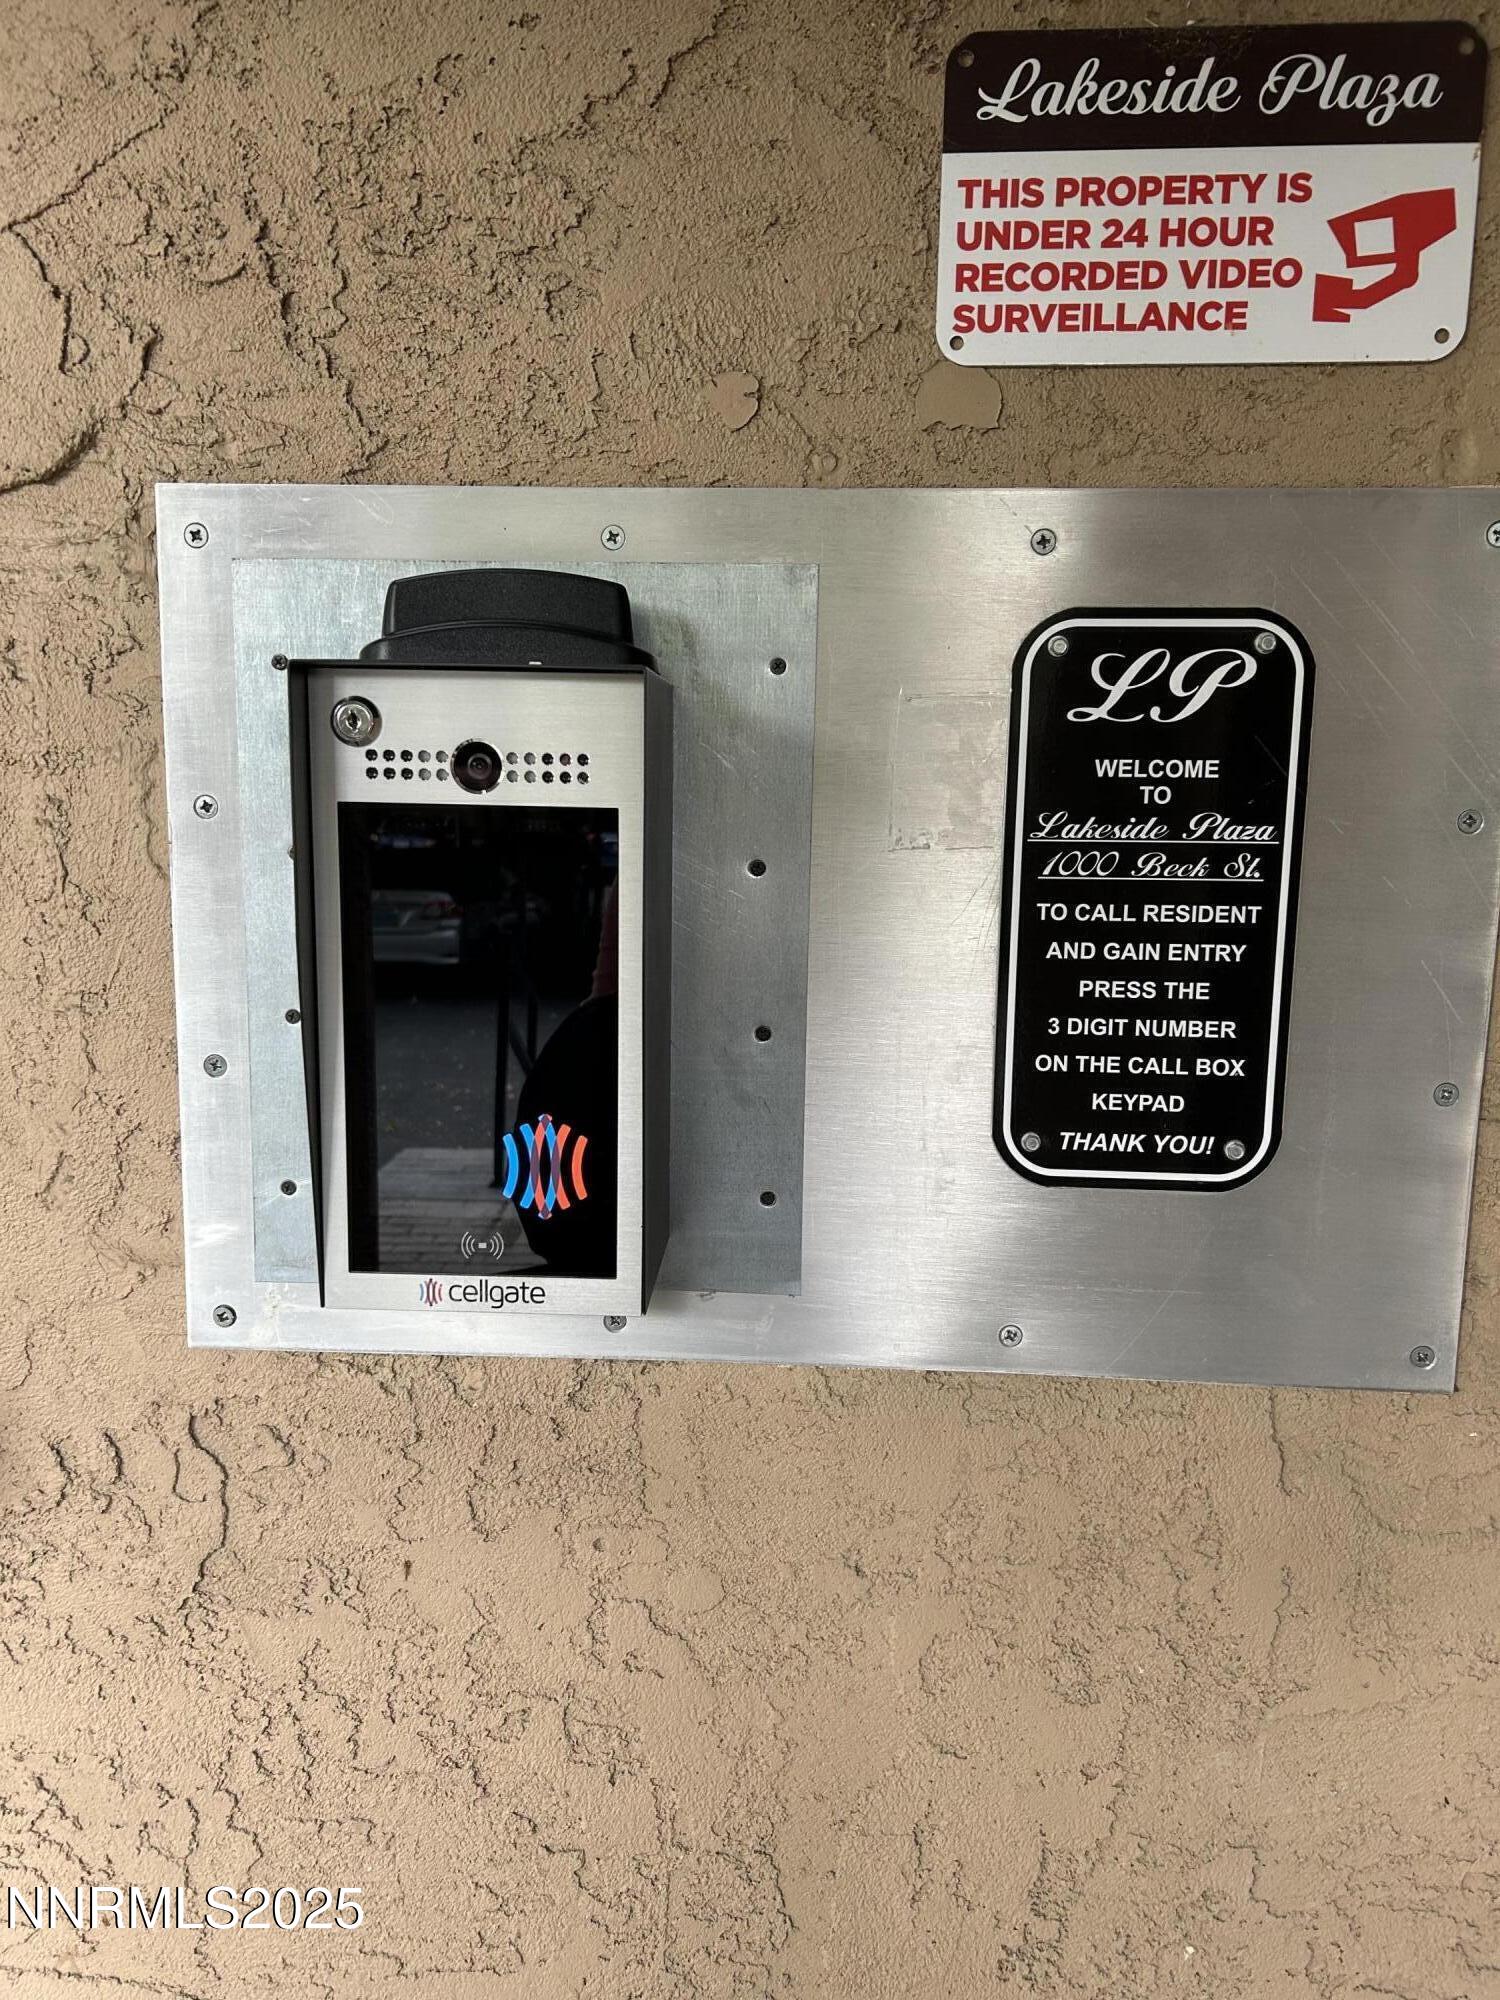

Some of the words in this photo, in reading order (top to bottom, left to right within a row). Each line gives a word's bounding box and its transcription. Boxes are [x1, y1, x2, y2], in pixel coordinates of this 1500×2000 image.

[977, 57, 1241, 123] Lakeside
[1259, 53, 1443, 127] Plaza
[957, 178, 1044, 209] THIS
[1056, 173, 1268, 207] PROPERTY
[1278, 172, 1312, 203] IS
[956, 219, 1090, 251] UNDER
[1101, 218, 1148, 249] 24
[1160, 216, 1273, 247] HOUR
[955, 260, 1167, 292] RECORDED
[1179, 257, 1302, 289] VIDEO
[953, 301, 1247, 333] SURVEILLANCE
[1067, 648, 1257, 723] LP
[1095, 759, 1220, 778] WELCOME
[1139, 786, 1172, 804] TO
[1030, 811, 1169, 840] Lakeside
[1182, 811, 1277, 841] Plaza
[1041, 851, 1119, 875] 1000
[1131, 852, 1209, 877] Beck
[1223, 853, 1261, 878] St.
[1036, 903, 1068, 921] TO
[1075, 903, 1136, 922] CALL
[1143, 905, 1262, 924] RESIDENT
[1046, 942, 1096, 960] AND
[1103, 942, 1160, 961] GAIN
[1168, 943, 1246, 962] ENTRY
[1078, 980, 1156, 999] PRESS
[1164, 982, 1210, 1000] THE
[1047, 1018, 1060, 1035] 3
[1067, 1018, 1128, 1036] DIGIT
[1135, 1019, 1236, 1039] NUMBER
[1035, 1054, 1068, 1072] ON
[1076, 1055, 1121, 1074] THE
[1128, 1056, 1188, 1075] CALL
[1196, 1058, 1245, 1077] BOX
[1091, 1093, 1185, 1113] KEYPAD
[1059, 1132, 1146, 1153] THANK
[1154, 1134, 1215, 1155] YOU!
[449, 1280, 546, 1308] cellgate
